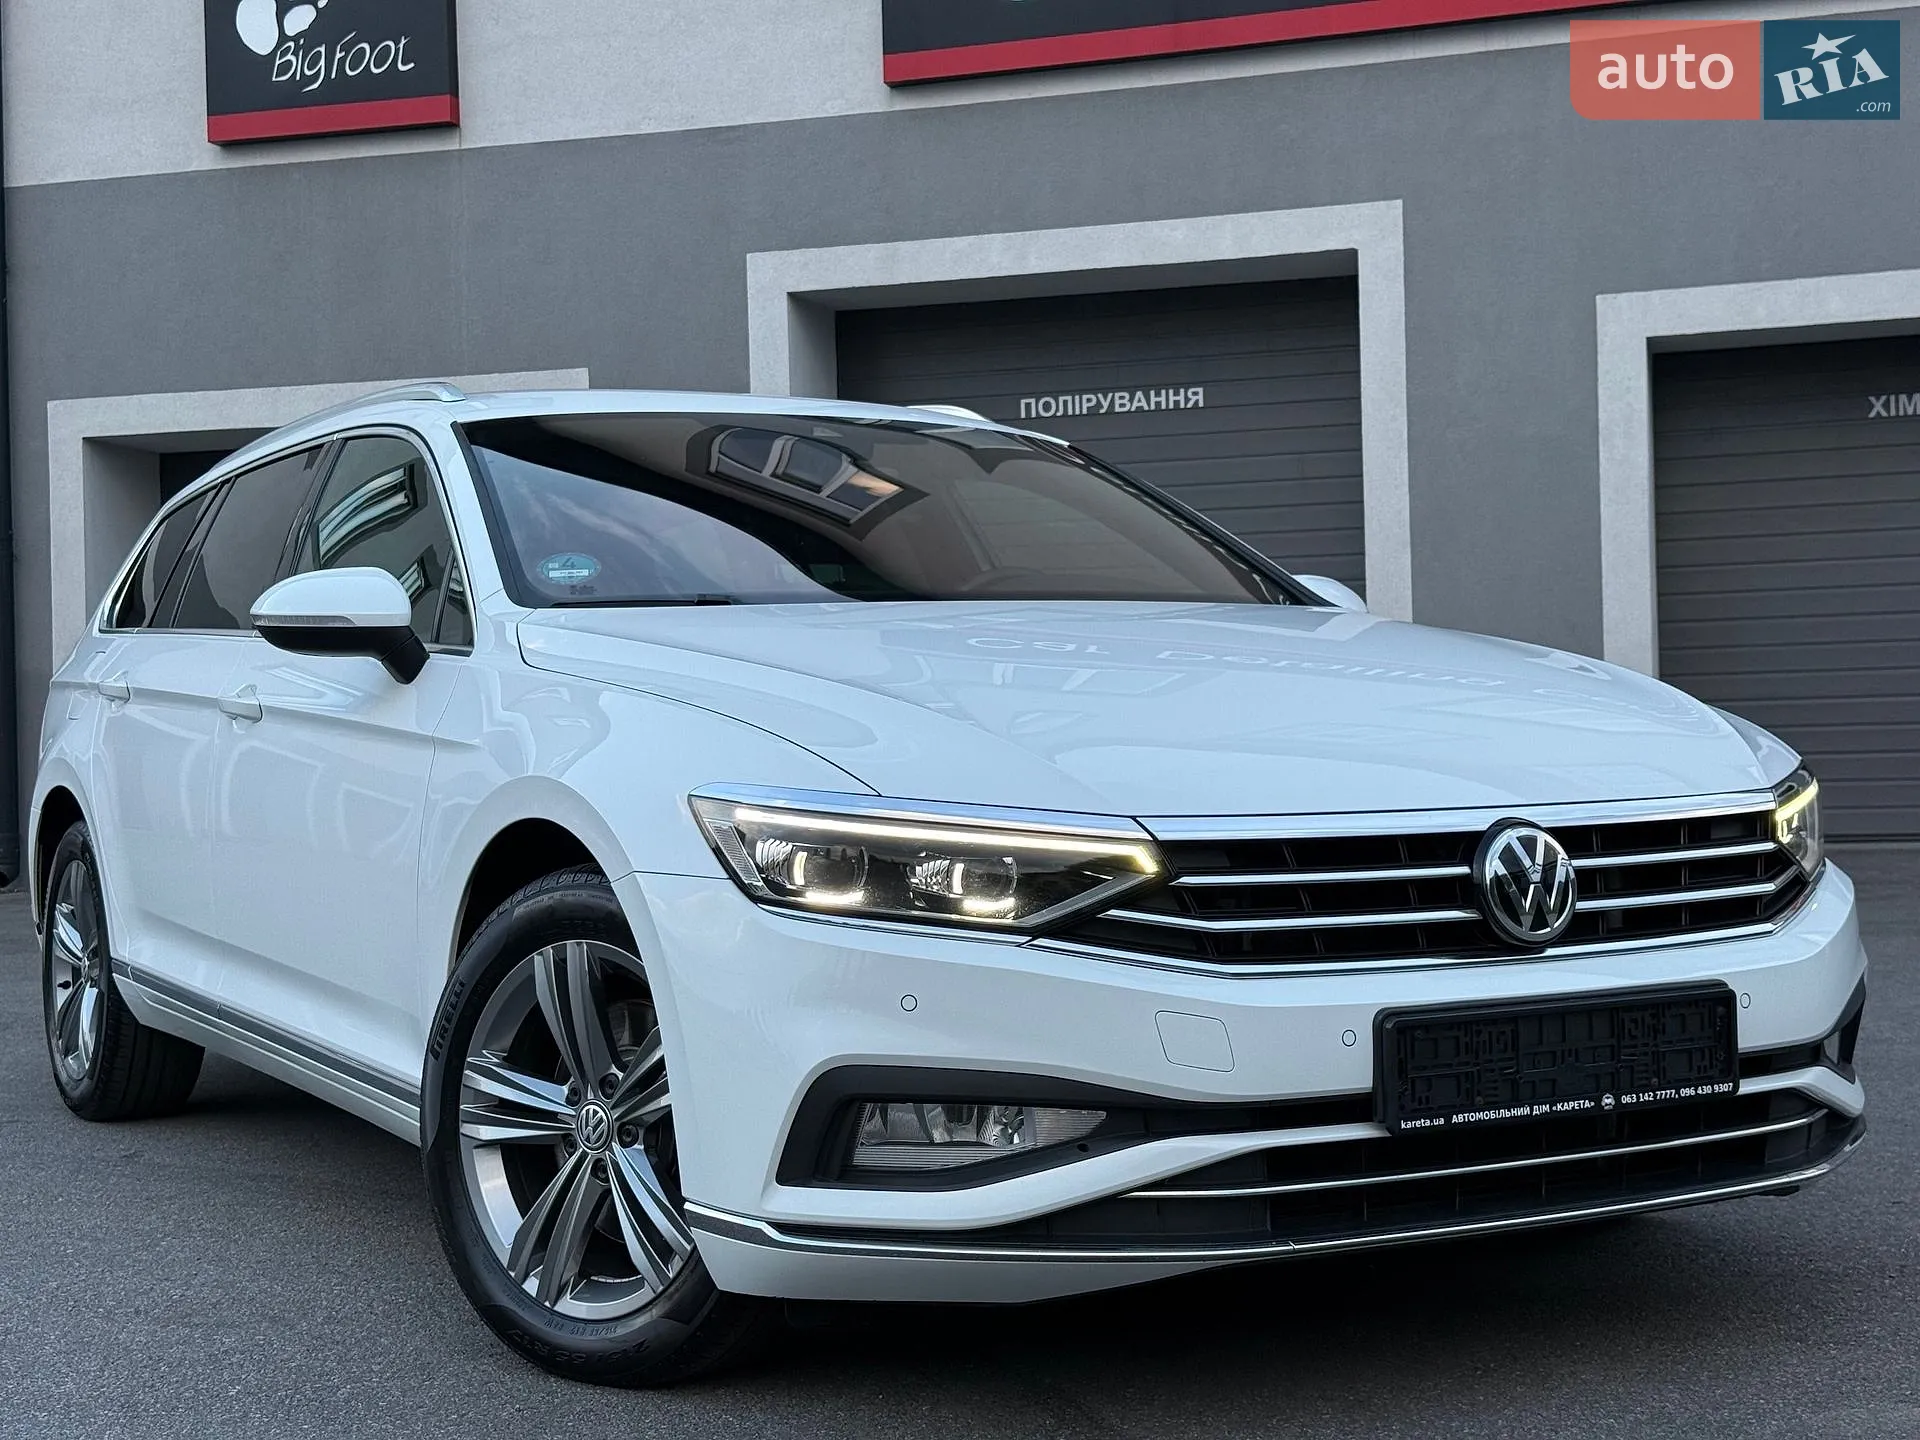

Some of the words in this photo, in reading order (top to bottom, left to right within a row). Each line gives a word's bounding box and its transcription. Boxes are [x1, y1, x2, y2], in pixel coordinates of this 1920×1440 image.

[1020, 387, 1205, 419] ПОЛІРУВАННЯ
[1867, 392, 1920, 418] ХІМ
[1621, 1093, 1637, 1104] 063
[1639, 1092, 1655, 1102] 142
[1655, 1089, 1679, 1100] 7777,
[1680, 1086, 1696, 1097] 096
[1696, 1085, 1712, 1095] 430
[1713, 1082, 1734, 1093] 9307
[1401, 1118, 1445, 1130] kareta.ua
[1451, 1104, 1531, 1124] АВТОМОБІЛЬНИЙ
[1532, 1103, 1550, 1116] ДІМ
[1551, 1099, 1595, 1112] «КАРЕТА»
